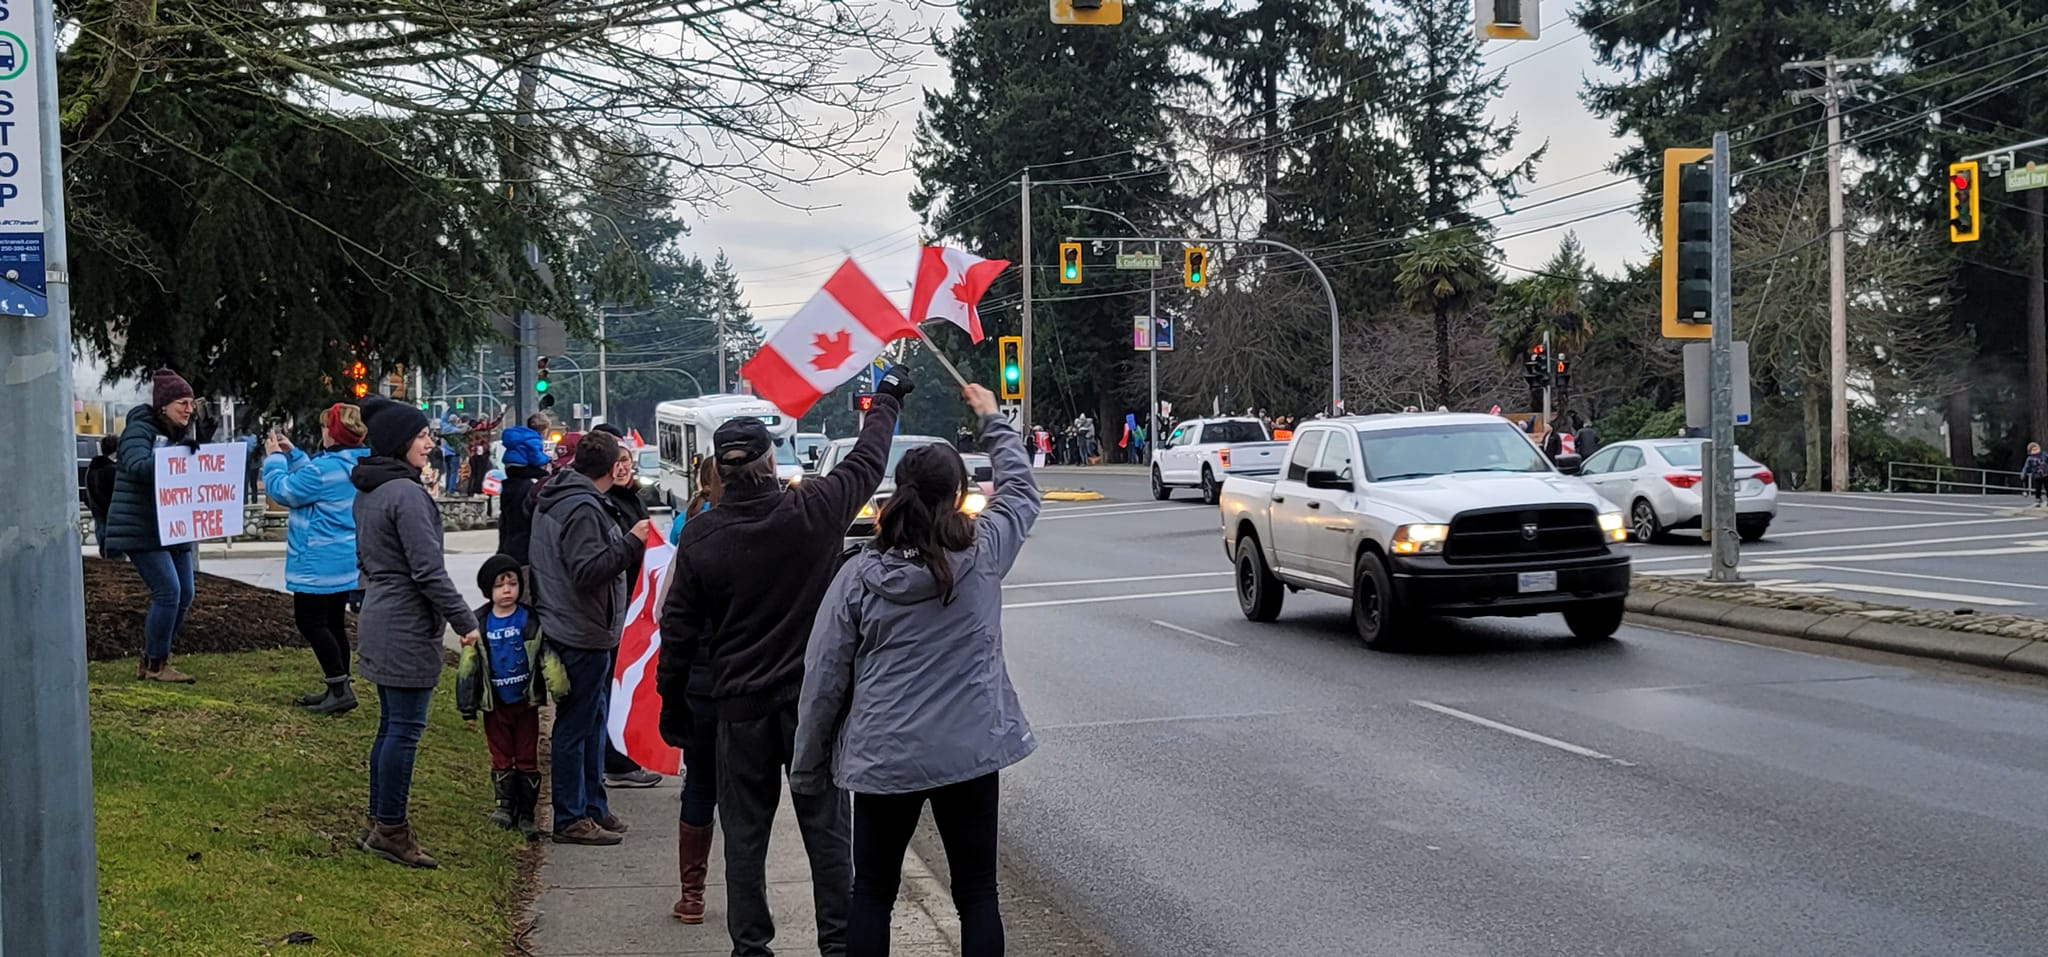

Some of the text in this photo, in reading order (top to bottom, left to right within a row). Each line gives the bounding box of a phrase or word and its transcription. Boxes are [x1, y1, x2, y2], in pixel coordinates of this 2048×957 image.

[0, 89, 19, 208] STOP
[168, 454, 225, 475] THE TRUE
[160, 484, 236, 507] NORTH STRONG
[169, 509, 223, 539] AND FREE
